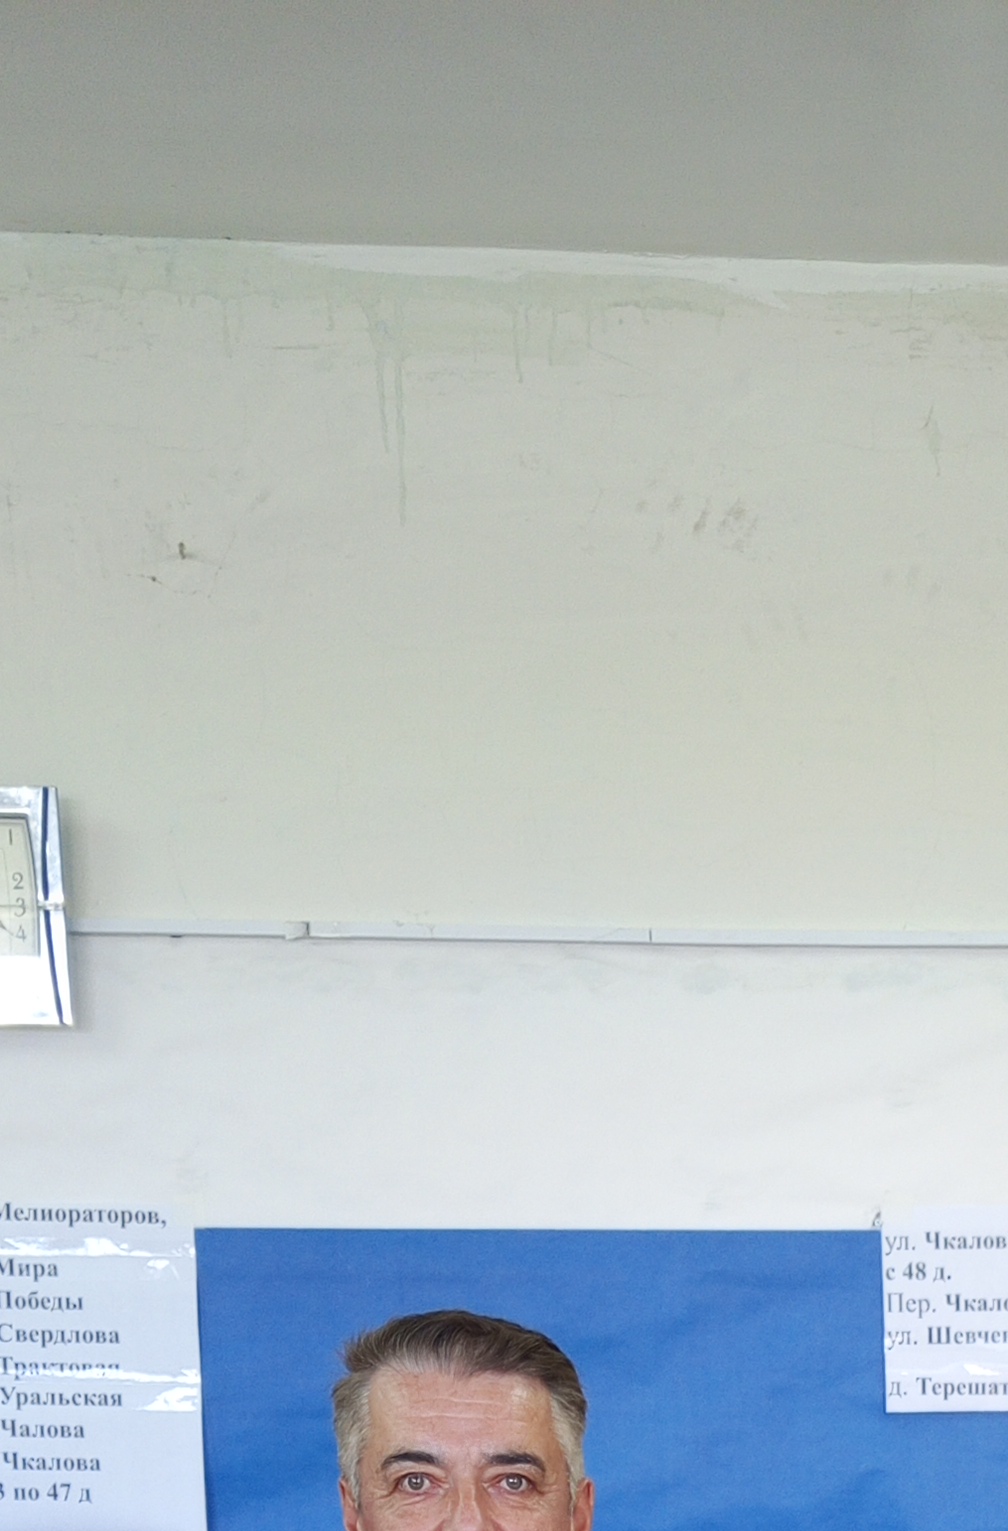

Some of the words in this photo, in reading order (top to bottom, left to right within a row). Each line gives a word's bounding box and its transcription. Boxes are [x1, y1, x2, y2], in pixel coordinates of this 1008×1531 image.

[12, 872, 24, 890] 2
[14, 897, 26, 917] 3
[15, 925, 27, 942] 4
[885, 1235, 916, 1256] ул.
[0, 1258, 59, 1282] Мира
[885, 1266, 896, 1281] с
[902, 1262, 927, 1281] 48
[933, 1266, 952, 1283] д.
[0, 1290, 83, 1312] Победы
[887, 1292, 936, 1319] Пер.
[0, 1323, 120, 1348] Свердлова
[887, 1330, 917, 1351] ул.
[0, 1386, 123, 1411] Уральская
[889, 1381, 907, 1398] д.
[1, 1419, 85, 1439] Чалова
[3, 1452, 102, 1472] Чкалова
[14, 1487, 40, 1501] по
[47, 1482, 72, 1502] 47
[78, 1488, 93, 1504] д
